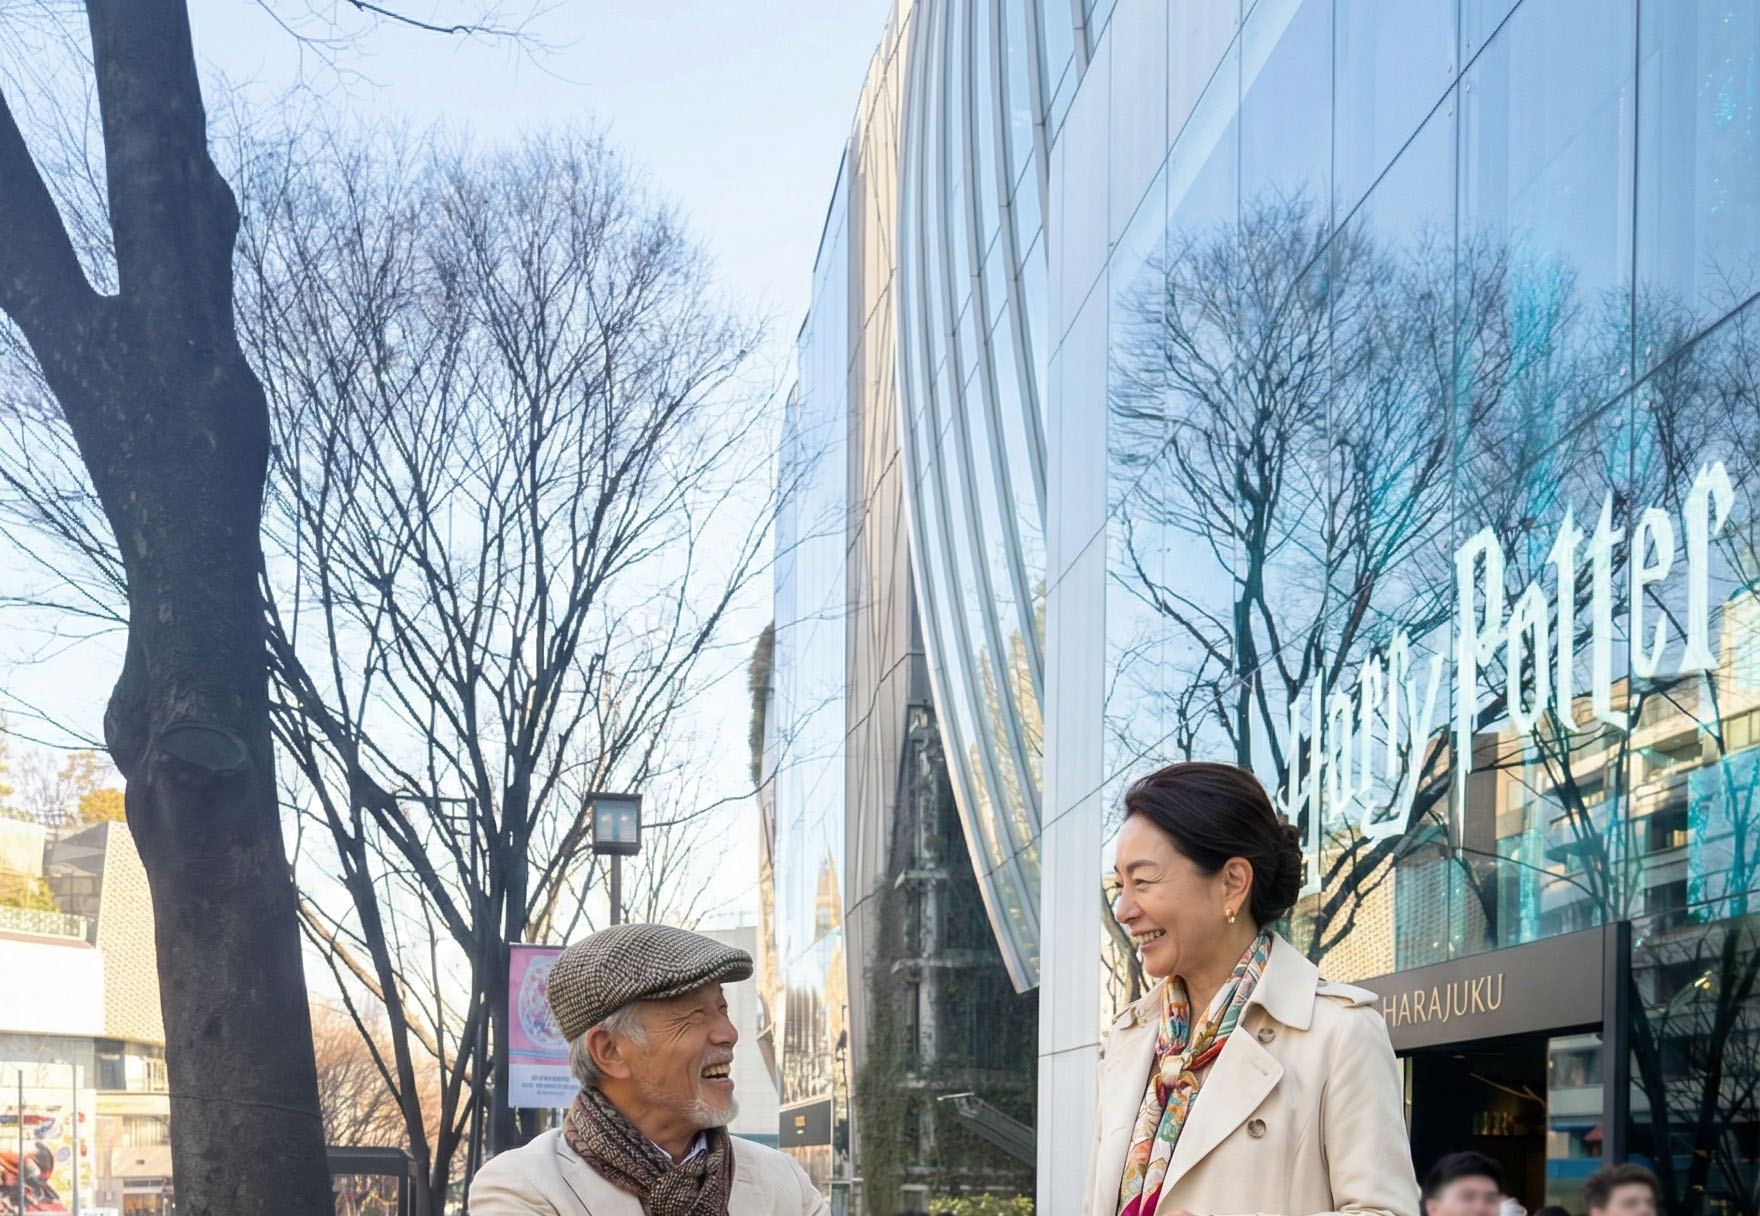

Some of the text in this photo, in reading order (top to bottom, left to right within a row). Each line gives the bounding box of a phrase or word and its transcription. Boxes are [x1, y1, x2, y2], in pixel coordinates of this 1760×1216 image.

[1277, 460, 1735, 896] Harry Potter
[1382, 973, 1504, 1027] HARAJUKU
